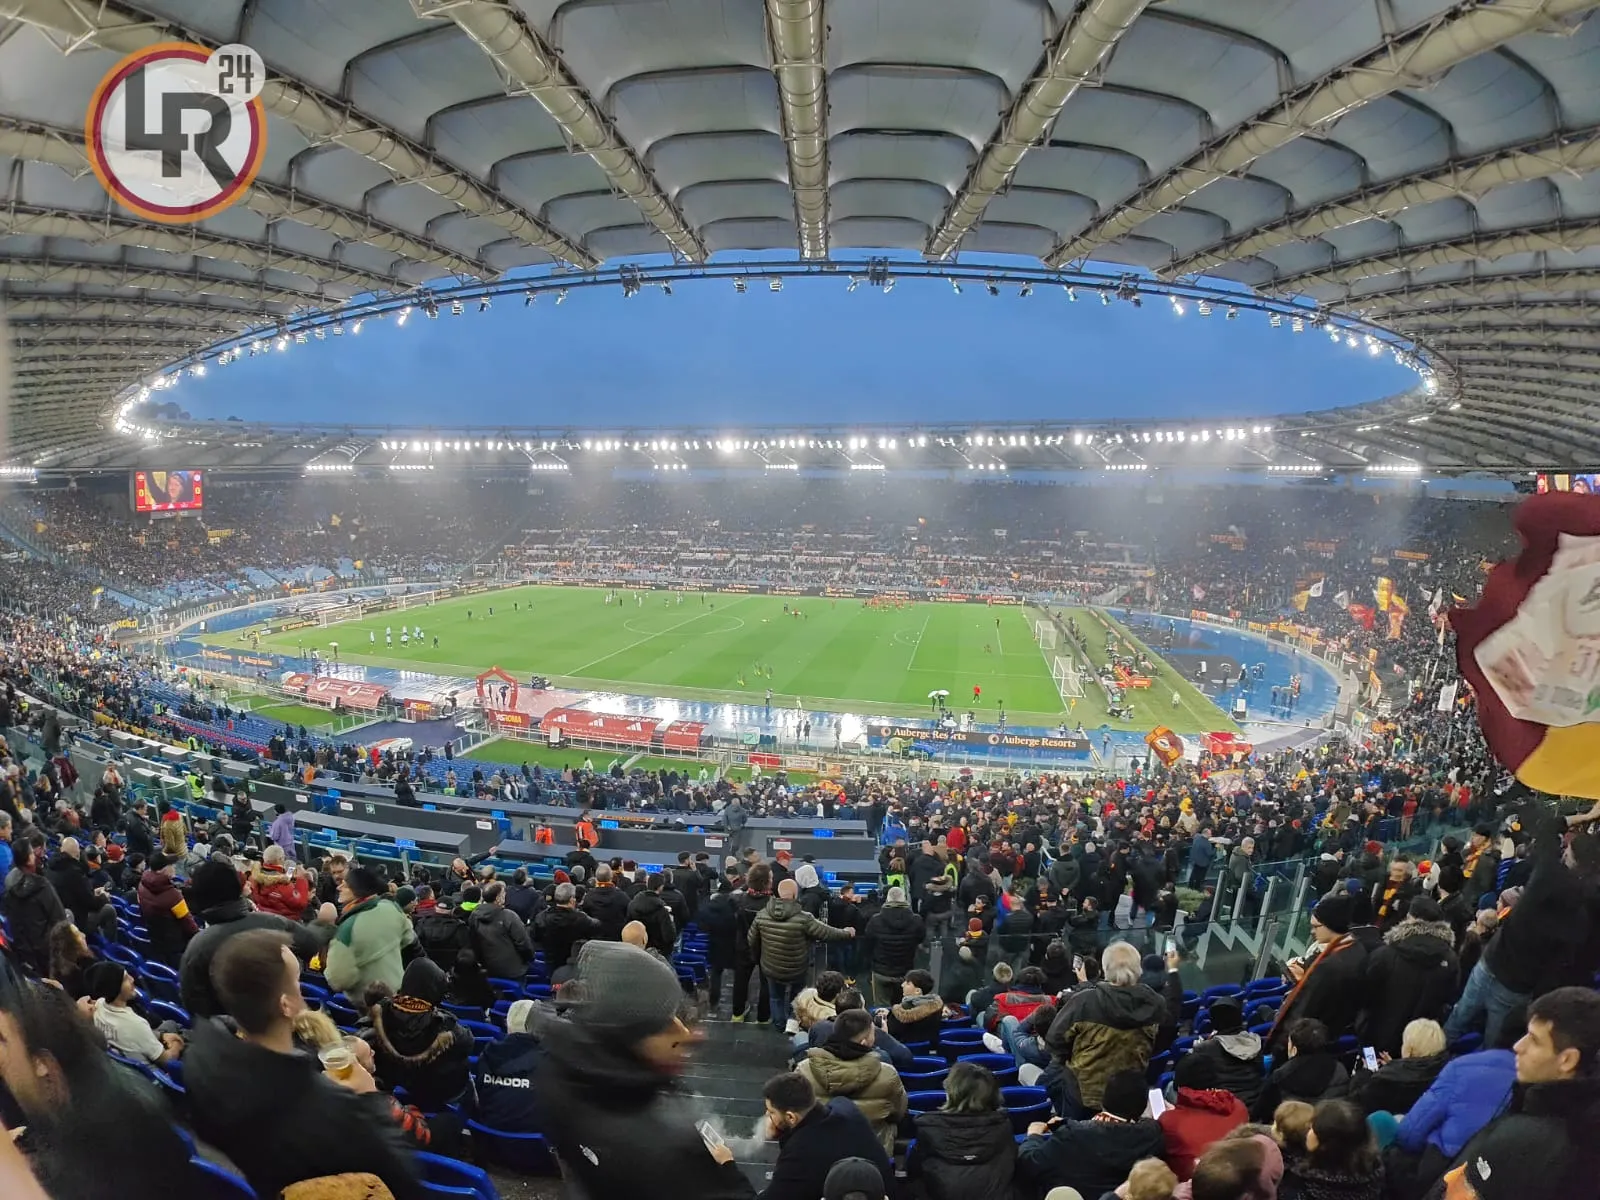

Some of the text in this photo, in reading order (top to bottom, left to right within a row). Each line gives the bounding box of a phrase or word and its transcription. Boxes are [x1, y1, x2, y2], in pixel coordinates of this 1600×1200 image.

[894, 728, 967, 740] Auberge Resrts
[1002, 735, 1077, 748] Auberge Resorts
[483, 1073, 530, 1089] DIADOR
